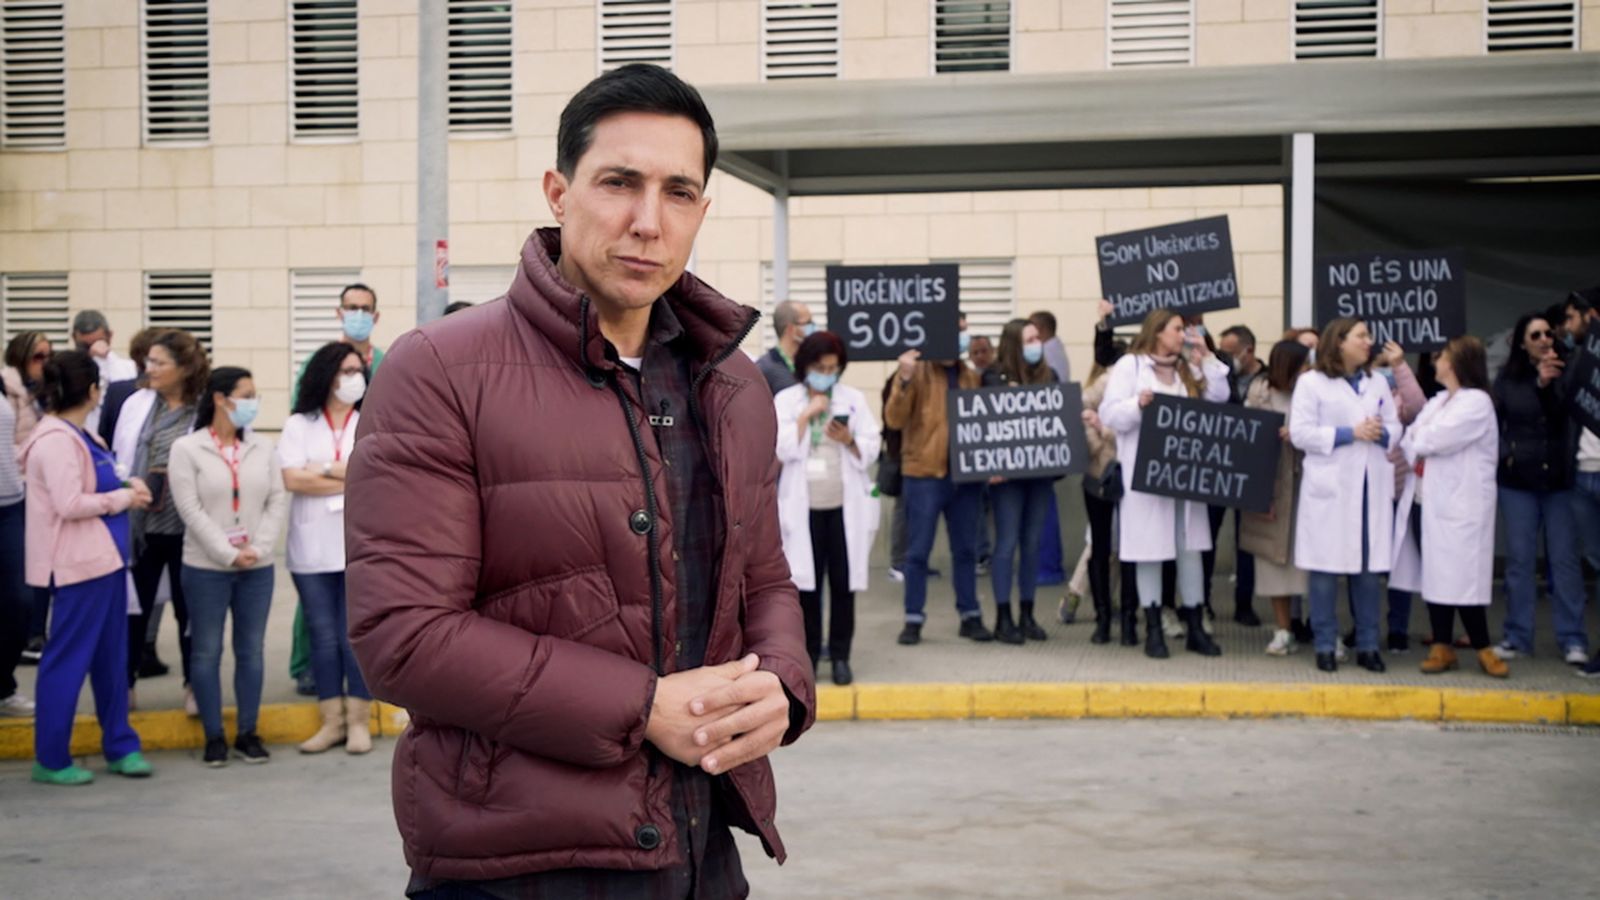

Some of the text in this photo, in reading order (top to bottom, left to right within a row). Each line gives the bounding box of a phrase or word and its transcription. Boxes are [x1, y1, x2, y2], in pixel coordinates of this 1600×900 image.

[1100, 241, 1141, 266] SOM
[1146, 259, 1179, 283] NO
[1329, 256, 1452, 286] NO ÉS UNA
[848, 311, 926, 348] SOS
[1365, 316, 1447, 345] UNTUAL
[957, 385, 1064, 418] LA VOCACIÓ
[957, 415, 1067, 444] NO JUSTIFICA
[1157, 403, 1261, 443] DIGNITAT
[1164, 435, 1234, 467] PER AL
[1145, 459, 1249, 498] PACIENT
